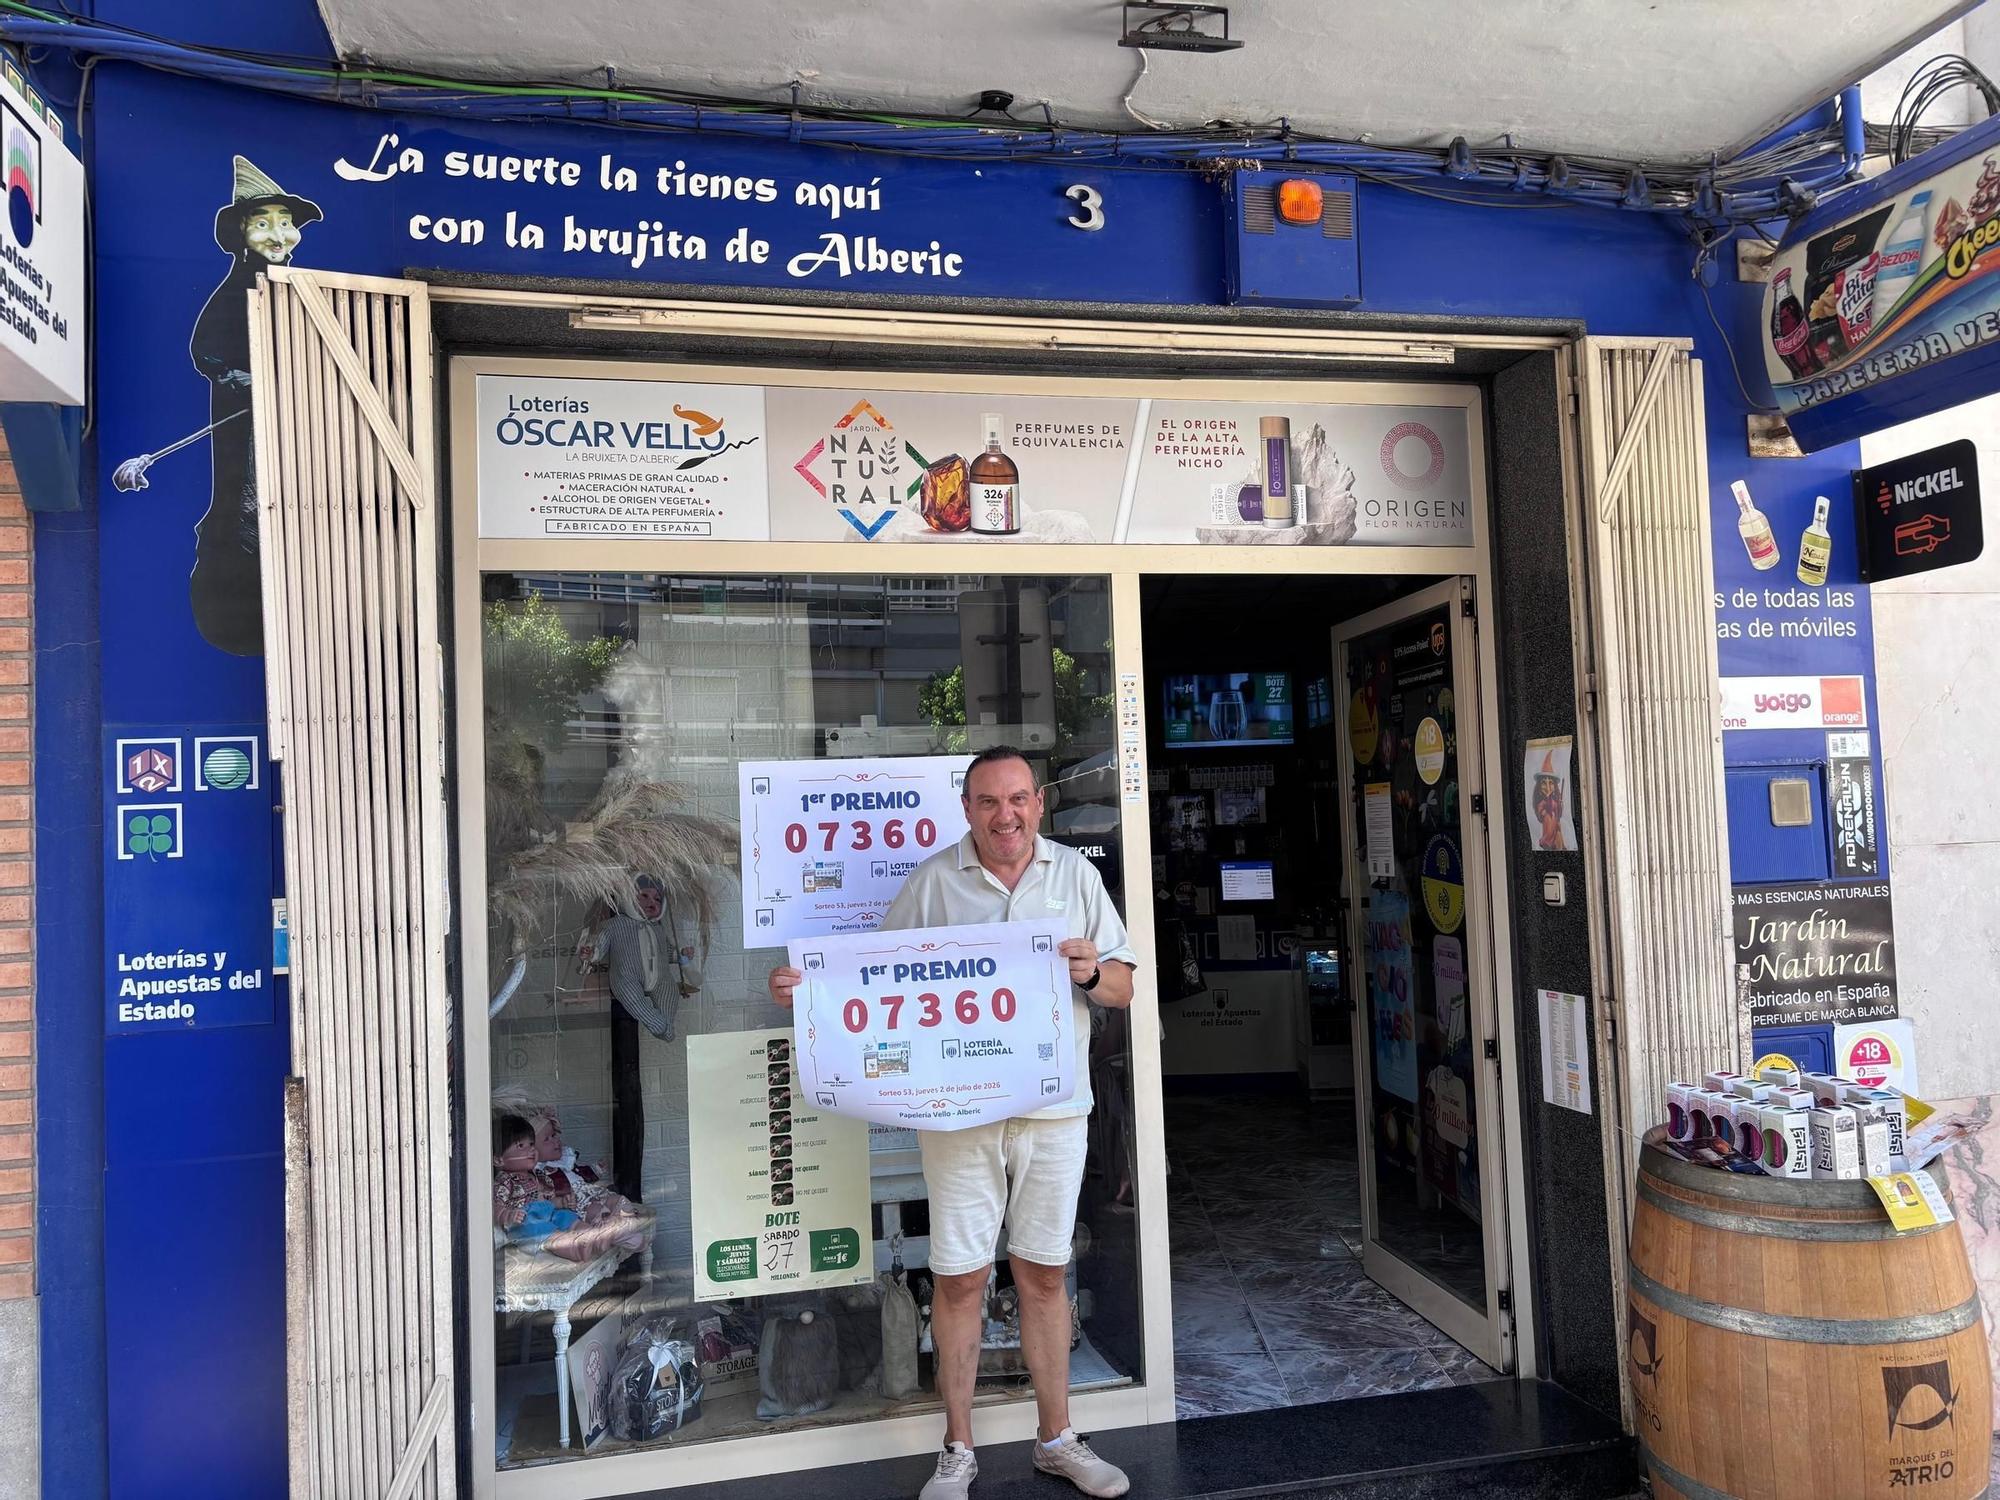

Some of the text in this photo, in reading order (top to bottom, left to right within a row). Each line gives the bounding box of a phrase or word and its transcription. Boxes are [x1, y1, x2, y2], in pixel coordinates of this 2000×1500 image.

[334, 132, 881, 219] La suerte la tienes aquí
[1065, 184, 1105, 231] 3
[408, 211, 963, 279] con la brujita de Alberic
[1946, 219, 2000, 280] Chee
[1880, 249, 1921, 267] BEZOYA
[46, 280, 52, 303] y
[0, 267, 67, 341] Apuestas del
[508, 395, 589, 413] Loterías
[496, 413, 725, 451] ÓSCAR VELLO
[850, 424, 881, 433] JARDÍN
[1015, 423, 1120, 435] PERFUMES DE
[1161, 419, 1237, 430] EL ORIGEN
[1012, 437, 1125, 449] EQUIVALENCIA
[1157, 432, 1239, 443] DE LA ALTA
[566, 452, 579, 462] LA
[581, 453, 628, 463] BRUIXETA
[1154, 444, 1246, 456] PERFUMERÍA
[1178, 458, 1223, 468] NICHO
[534, 472, 719, 483] MATERIAS PRIMAS DE GRAN CALIDAD
[568, 483, 686, 494] MACERACIÓN NATURAL
[983, 489, 1004, 499] 326
[551, 495, 704, 505] ALCOHOL DE ORIGEN VEGETAL
[1365, 500, 1465, 518] ORIGEN
[539, 506, 715, 517] ESTRUCTURA DE ALTA PERFUMERÍA
[556, 522, 700, 532] FABRICADO EN ESPAÑA
[1365, 520, 1465, 529] FLOR NATURAL
[1732, 587, 1855, 608] de todas las
[1747, 617, 1856, 639] de móviles
[1268, 687, 1283, 699] 27
[1754, 693, 1811, 713] yoigo
[1824, 713, 1859, 723] orange
[800, 790, 921, 812] 1er PREMIO
[1840, 763, 1857, 868] ADRENALYN
[784, 818, 937, 853] 07360
[1072, 846, 1106, 857] CKEL
[890, 860, 918, 870] LOTERÍ
[1738, 893, 1763, 905] MAS
[1766, 890, 1822, 904] ESENCIAS
[1824, 886, 1889, 901] NATURALES
[1739, 908, 1850, 950] Jardín
[118, 951, 226, 972] Loterías y
[1750, 940, 1889, 983] Natural
[860, 957, 997, 985] 1er PREMIO
[119, 969, 262, 1000] Apuestas del
[1749, 982, 1890, 1009] abricado en España
[118, 1000, 195, 1022] Estado
[843, 987, 1017, 1033] 07360
[1753, 1004, 1896, 1026] PERFUME DE MARCA BLANCA
[963, 1038, 1003, 1049] LOTERÍA
[964, 1047, 1014, 1057] NACIONAL
[1857, 1041, 1882, 1059] +18
[878, 1089, 902, 1097] Sorteo
[903, 1088, 914, 1096] 53,
[915, 1087, 938, 1096] jueves
[956, 1084, 972, 1093] julio
[957, 1108, 981, 1116] Alberic
[765, 1211, 800, 1227] BOTE
[764, 1229, 800, 1243] SABADO
[764, 1242, 793, 1271] 27
[717, 1356, 757, 1374] STORAGE
[1889, 1449, 1955, 1466] MARQUÉS DEL
[1888, 1461, 1955, 1488] ATRIO
